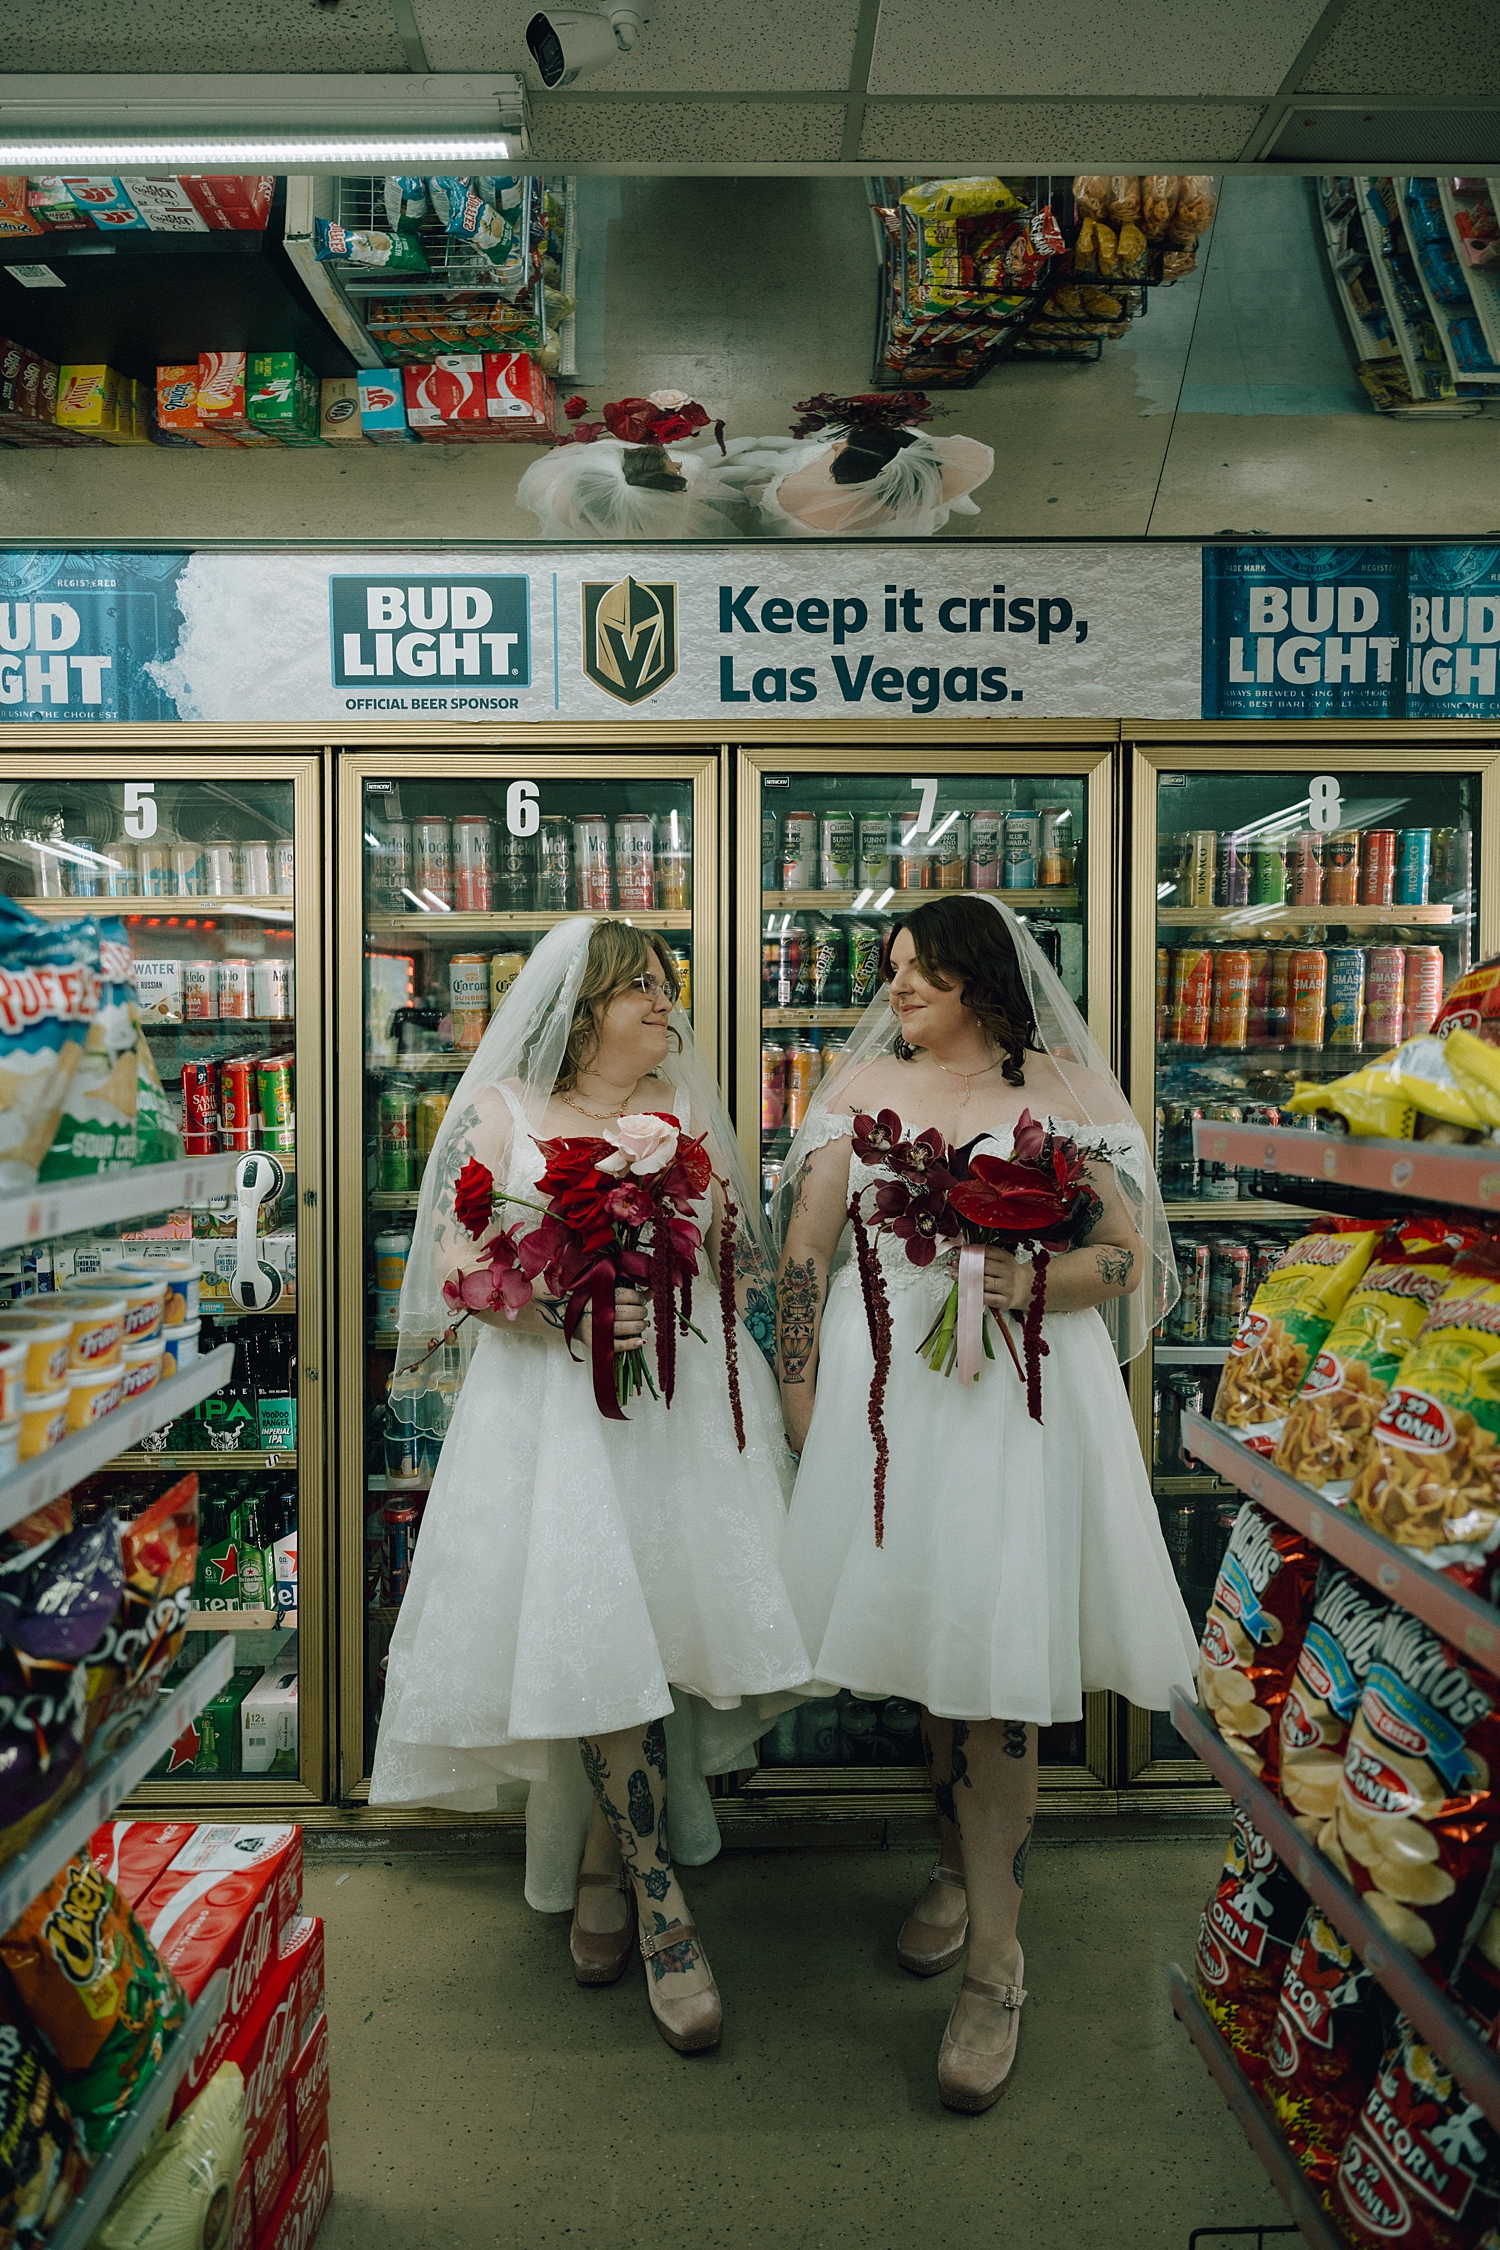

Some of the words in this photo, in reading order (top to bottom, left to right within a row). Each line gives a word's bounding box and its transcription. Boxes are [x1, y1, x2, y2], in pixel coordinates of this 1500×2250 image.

[1243, 564, 1267, 572] MARK
[0, 602, 81, 652] UD
[367, 586, 493, 630] BUD
[719, 585, 868, 645] Keep
[884, 584, 923, 633] it
[938, 584, 1089, 645] crisp,
[1250, 586, 1380, 633] BUD
[0, 653, 112, 704] GHT
[344, 633, 518, 677] LIGHT
[1229, 635, 1400, 685] LIGHT
[1406, 646, 1500, 696] LIGH
[345, 699, 407, 710] OFFICIAL
[410, 698, 449, 710] BEER
[451, 698, 519, 710] SPONSOR
[719, 655, 818, 702] Las
[831, 655, 1024, 713] Vegas.
[1249, 700, 1274, 708] BEST
[1255, 689, 1297, 698] BREWED
[124, 782, 158, 839] 5
[506, 780, 541, 838] 6
[911, 778, 938, 833] 7
[1308, 775, 1342, 832] 8
[864, 836, 887, 844] SUNNY
[1197, 848, 1208, 896] MONACO
[1220, 848, 1230, 896] MONACO
[1262, 848, 1272, 896] MONACO
[1296, 848, 1305, 896] MONACO
[1368, 846, 1380, 895] MONACO
[1407, 845, 1420, 893] MONACO
[134, 963, 175, 975] WATER
[1195, 982, 1205, 1023] SMASH
[192, 1094, 217, 1104] SAMU
[217, 1388, 249, 1396] ONE
[268, 1435, 283, 1444] IPA
[1395, 1412, 1446, 1447] ONLY
[1168, 1528, 1190, 1538] OLDE
[205, 1566, 212, 1577] 6
[1354, 1777, 1399, 1812] ONLY
[1366, 2098, 1451, 2196] FFCORN
[1355, 2179, 1398, 2226] ONLY
